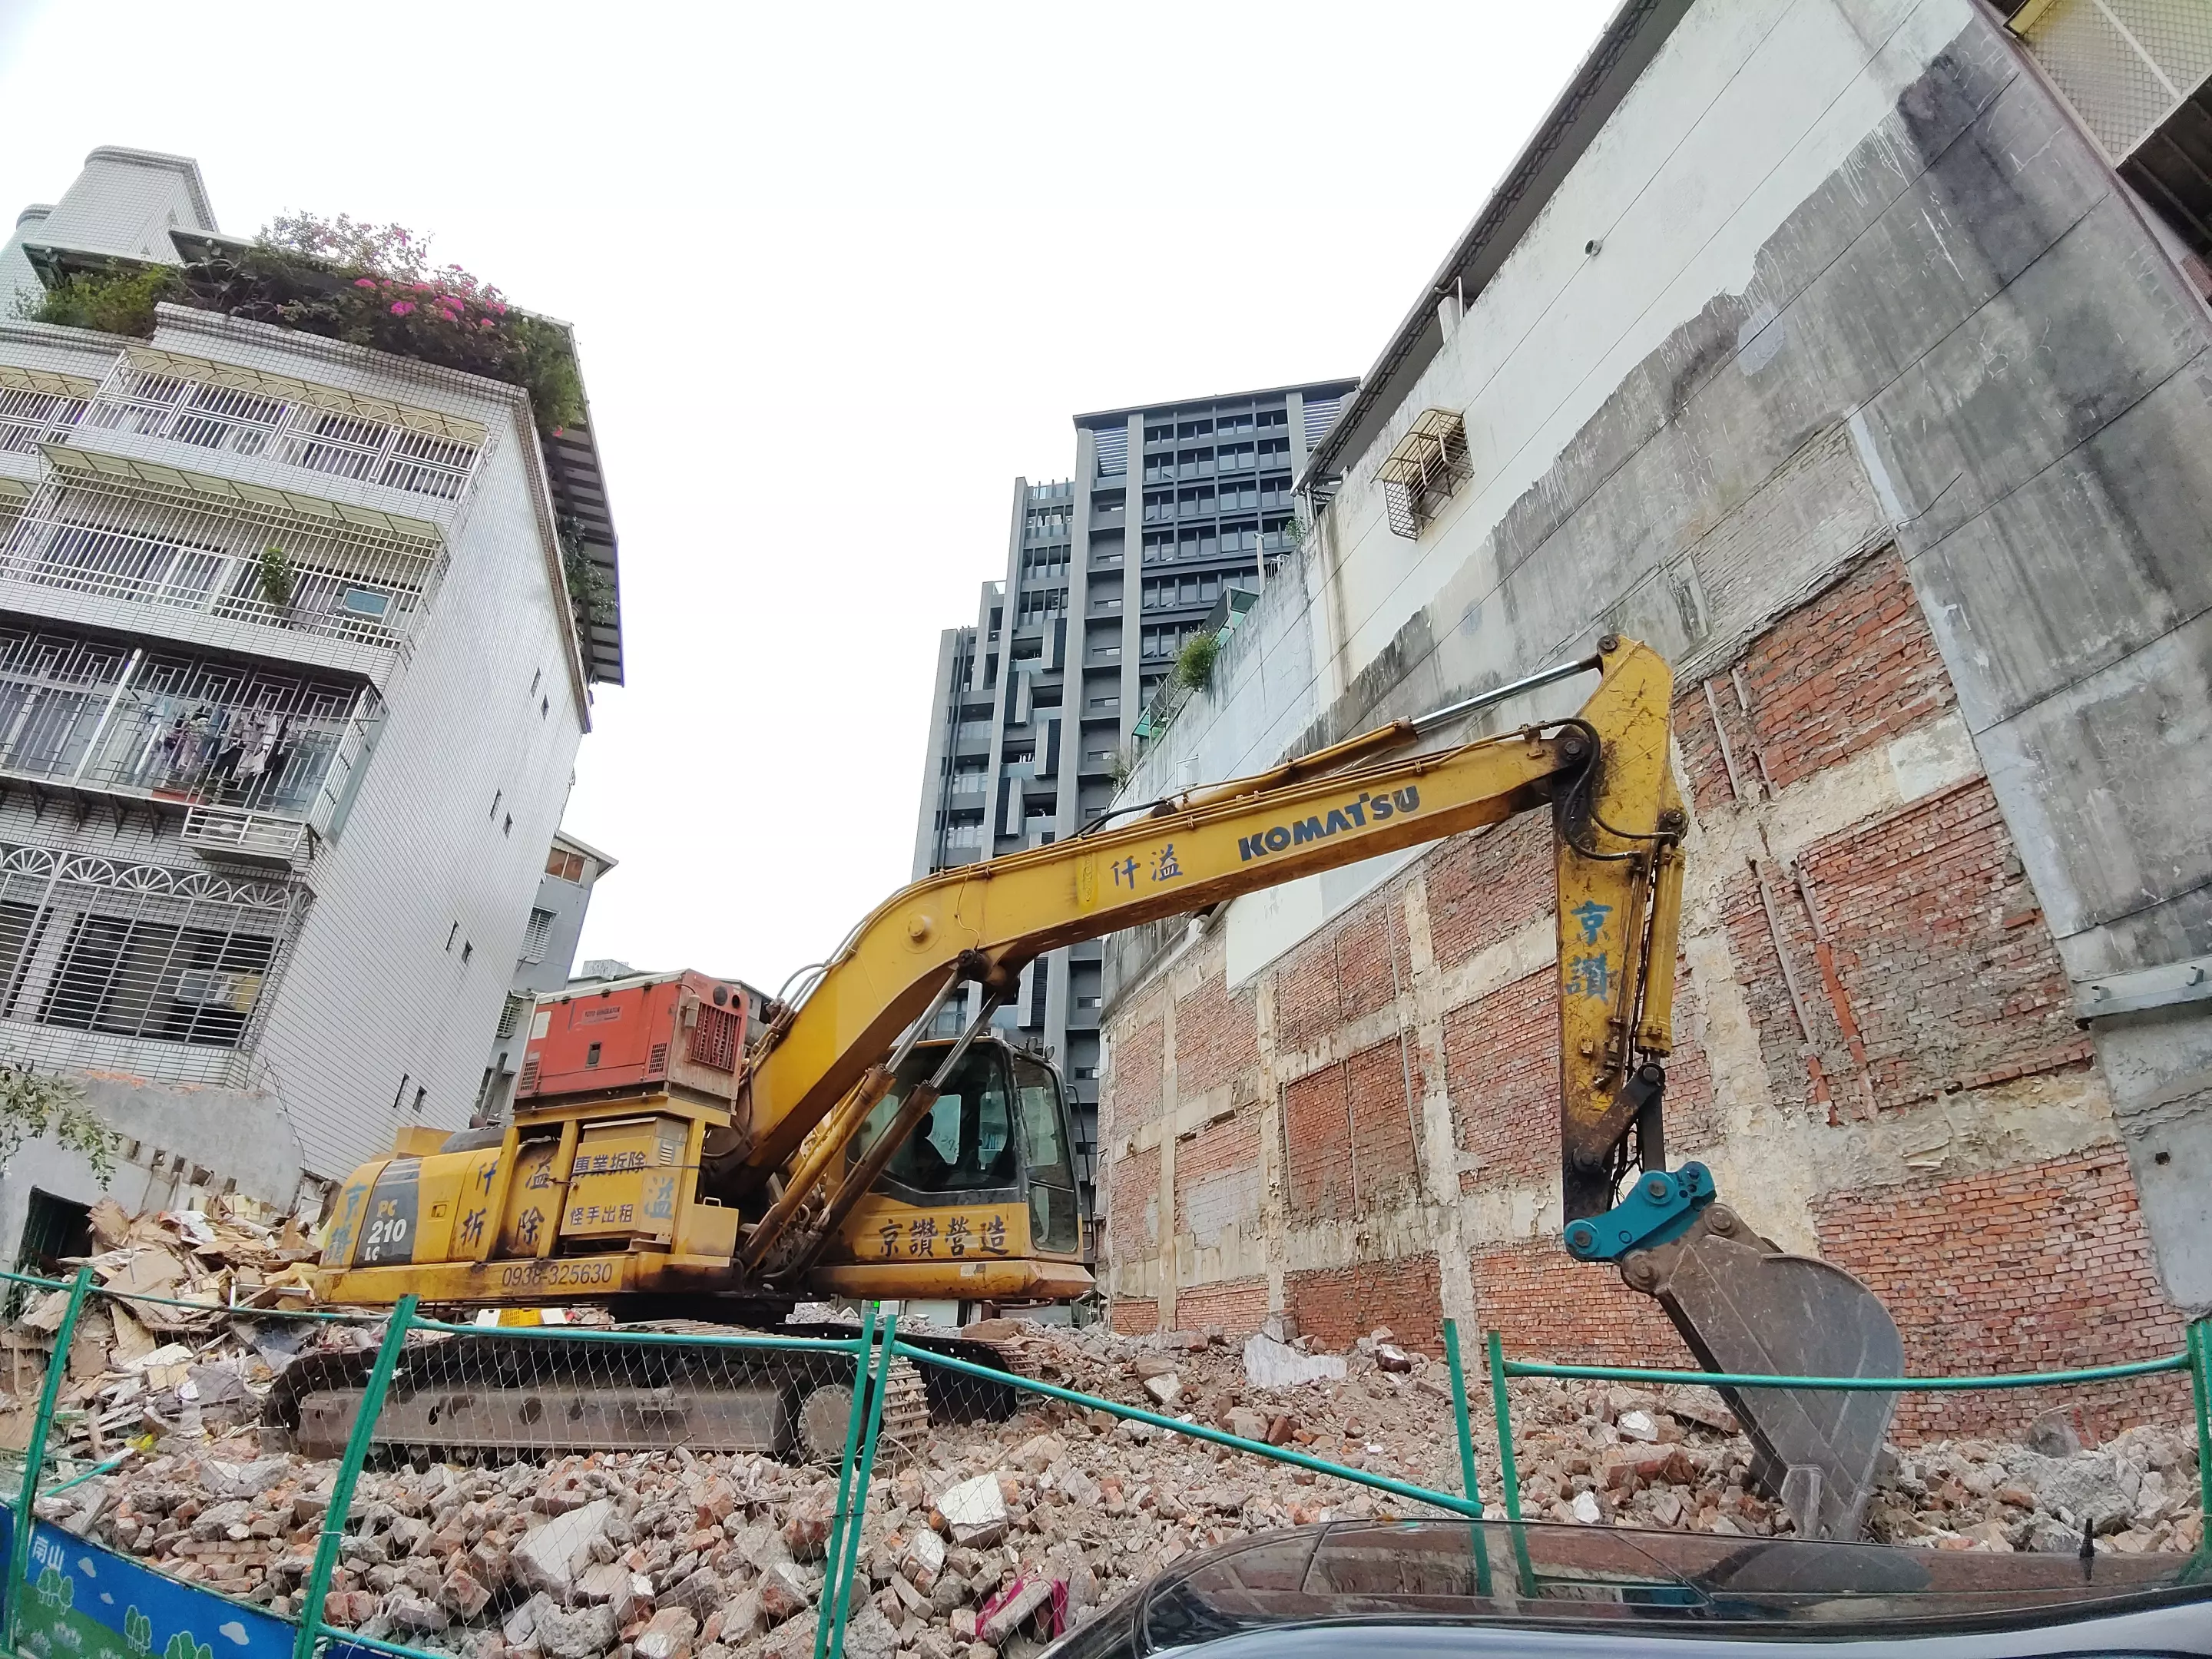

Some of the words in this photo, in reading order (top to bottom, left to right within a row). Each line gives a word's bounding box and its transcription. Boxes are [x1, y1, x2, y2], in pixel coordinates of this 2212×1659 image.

[1238, 785, 1420, 862] KOMATSU
[1110, 843, 1184, 890] 仟溢
[376, 1199, 398, 1217] PC
[570, 1204, 634, 1226] 怪手出租
[367, 1218, 407, 1244] 210
[879, 1214, 1010, 1258] 京讚營造
[364, 1247, 381, 1261] LC
[502, 1263, 613, 1287] 0938-325630
